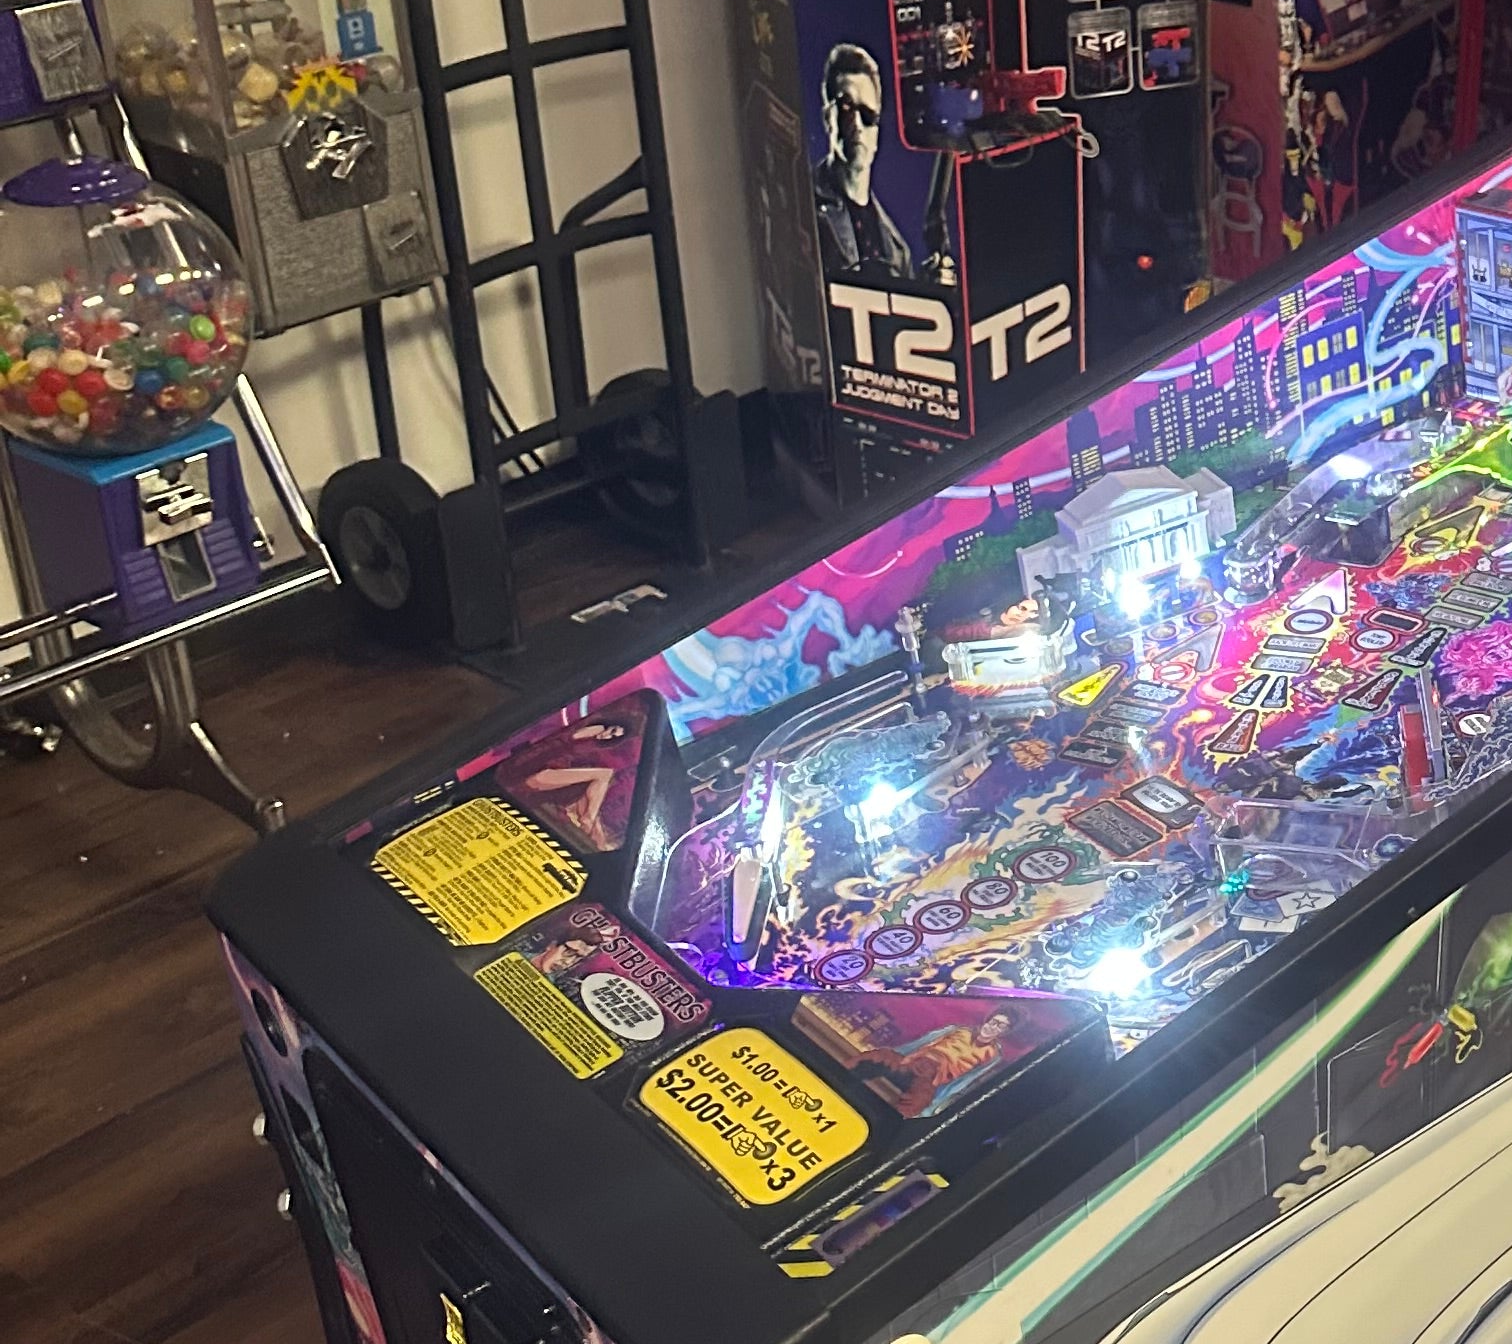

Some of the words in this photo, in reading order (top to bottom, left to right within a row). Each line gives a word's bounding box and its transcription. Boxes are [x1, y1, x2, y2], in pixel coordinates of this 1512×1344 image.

[830, 282, 956, 384] T2
[972, 283, 1073, 382] T2
[841, 364, 944, 399] TERMINATOR
[948, 388, 958, 403] 2
[841, 382, 924, 412] JUDGMENT
[687, 1053, 754, 1109] SUPER
[751, 1105, 823, 1171] VALUE
